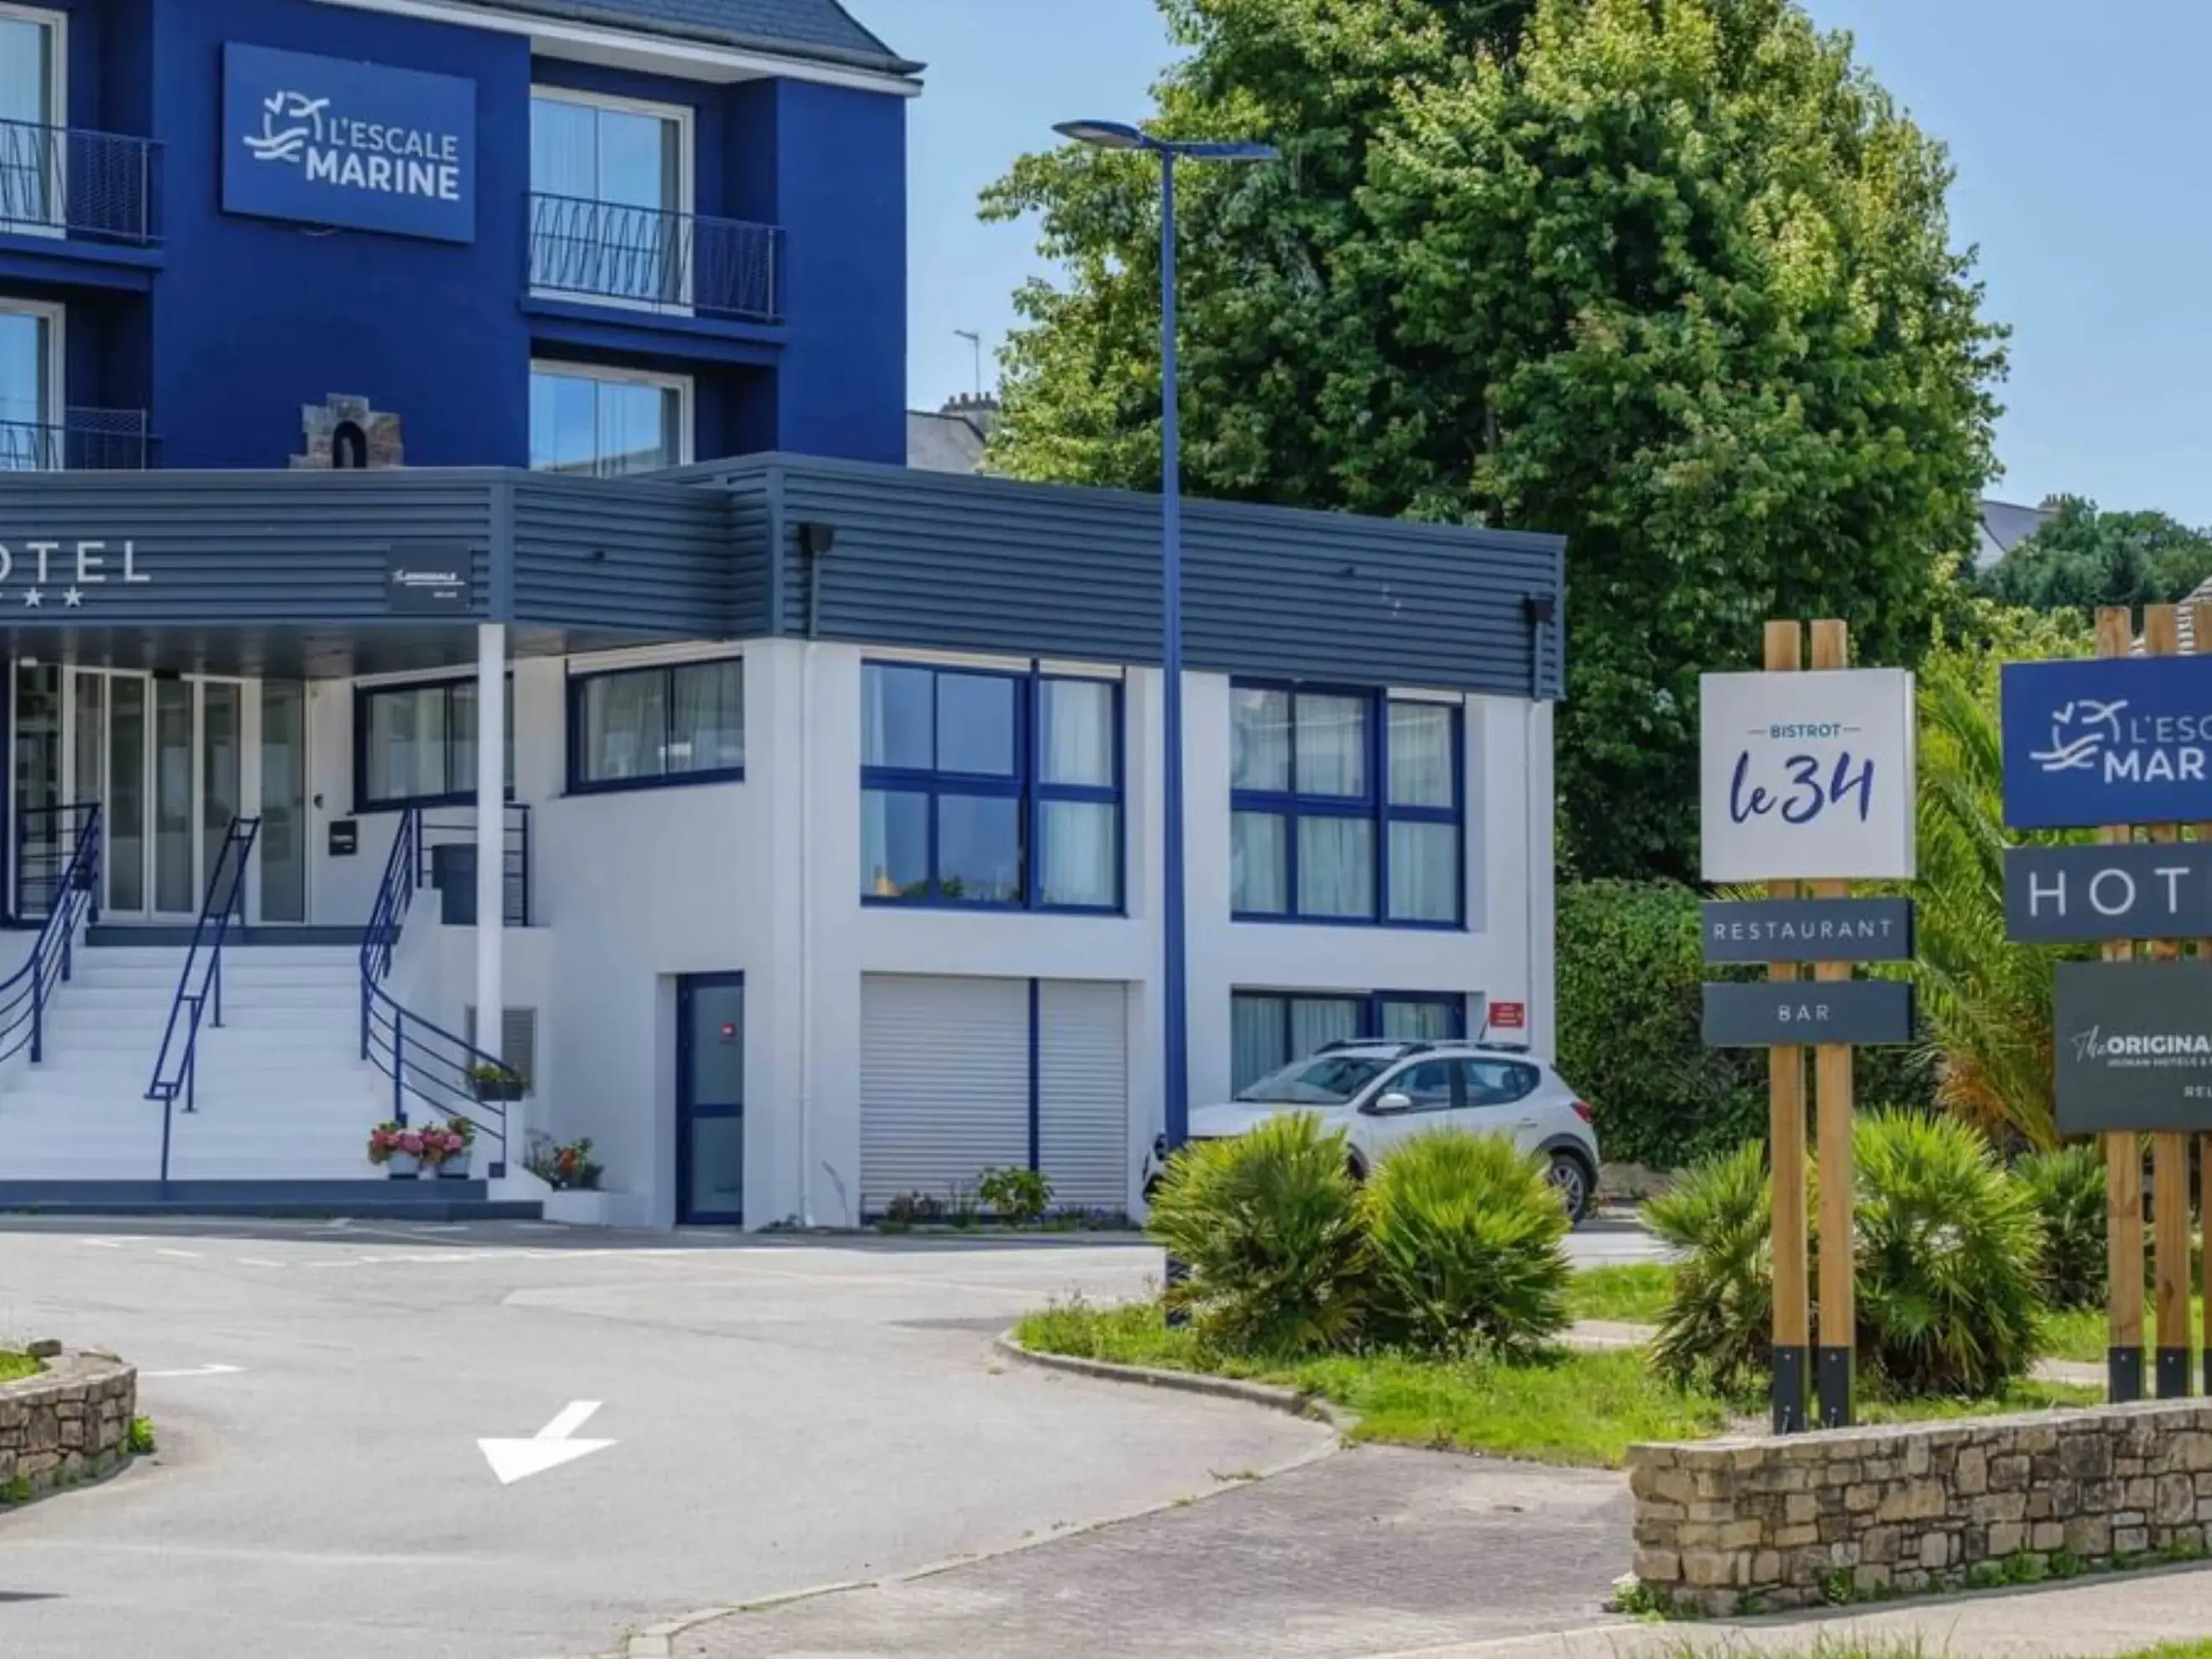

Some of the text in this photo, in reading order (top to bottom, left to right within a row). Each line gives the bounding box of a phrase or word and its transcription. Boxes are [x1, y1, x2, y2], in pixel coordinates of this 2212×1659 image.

[330, 117, 457, 162] L'ESCALE
[306, 146, 460, 201] MARINE
[0, 541, 151, 583] TEL
[1770, 723, 1841, 739] BISTROT
[2104, 747, 2205, 783] MAR
[2029, 867, 2190, 917] HOT
[1713, 919, 1892, 940] RESTAURANT
[1778, 1005, 1829, 1021] BAR
[2106, 1035, 2212, 1055] ORIGINA
